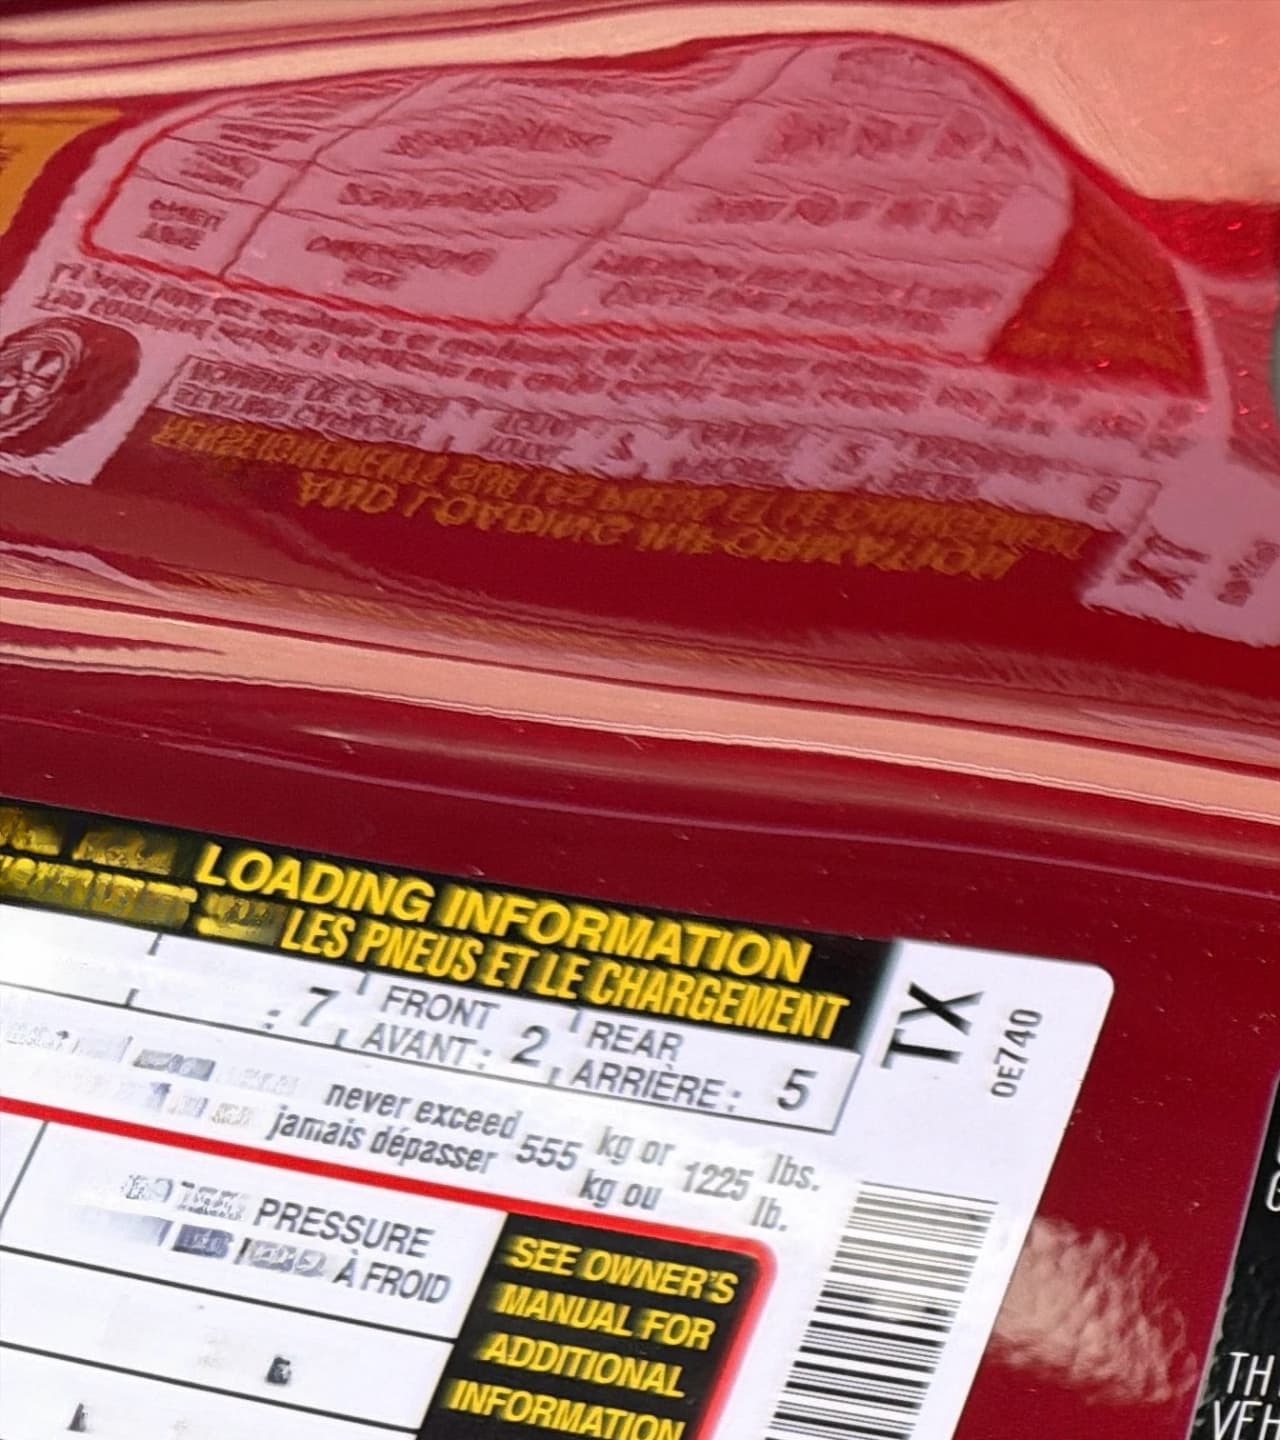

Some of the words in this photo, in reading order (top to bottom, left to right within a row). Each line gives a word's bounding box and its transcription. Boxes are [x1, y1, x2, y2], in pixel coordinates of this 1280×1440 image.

[195, 841, 436, 923] LOADING
[441, 883, 811, 983] INFORMATION
[281, 908, 356, 959] LES
[358, 924, 478, 981] PNEUS
[480, 947, 537, 989] ET
[537, 959, 585, 999] LE
[587, 960, 850, 1040] CHARGEMENT
[379, 985, 502, 1030] FRONT
[587, 1018, 684, 1060] REAR
[881, 982, 985, 1070] TX
[511, 1026, 549, 1066] 2
[777, 1069, 817, 1111] 5
[266, 1104, 363, 1150] jamais
[370, 1123, 497, 1174] dépasser
[579, 1170, 613, 1208] kg
[623, 1182, 661, 1212] ou
[751, 1196, 788, 1233] lb.
[324, 1082, 410, 1119] never
[415, 1101, 523, 1140] exceed
[516, 1134, 581, 1171] 555
[596, 1127, 631, 1167] kg
[640, 1139, 675, 1165] or
[682, 1162, 754, 1201] 1225
[768, 1154, 821, 1193] lbs.
[253, 1198, 434, 1258] PRESSURE
[332, 1250, 357, 1286] À
[360, 1262, 452, 1304] FROID
[507, 1235, 578, 1274] SEE
[584, 1252, 738, 1304] OWNER'S
[494, 1284, 633, 1337] MANUAL
[641, 1309, 715, 1350] FOR
[478, 1333, 685, 1398] ADDITIONAL
